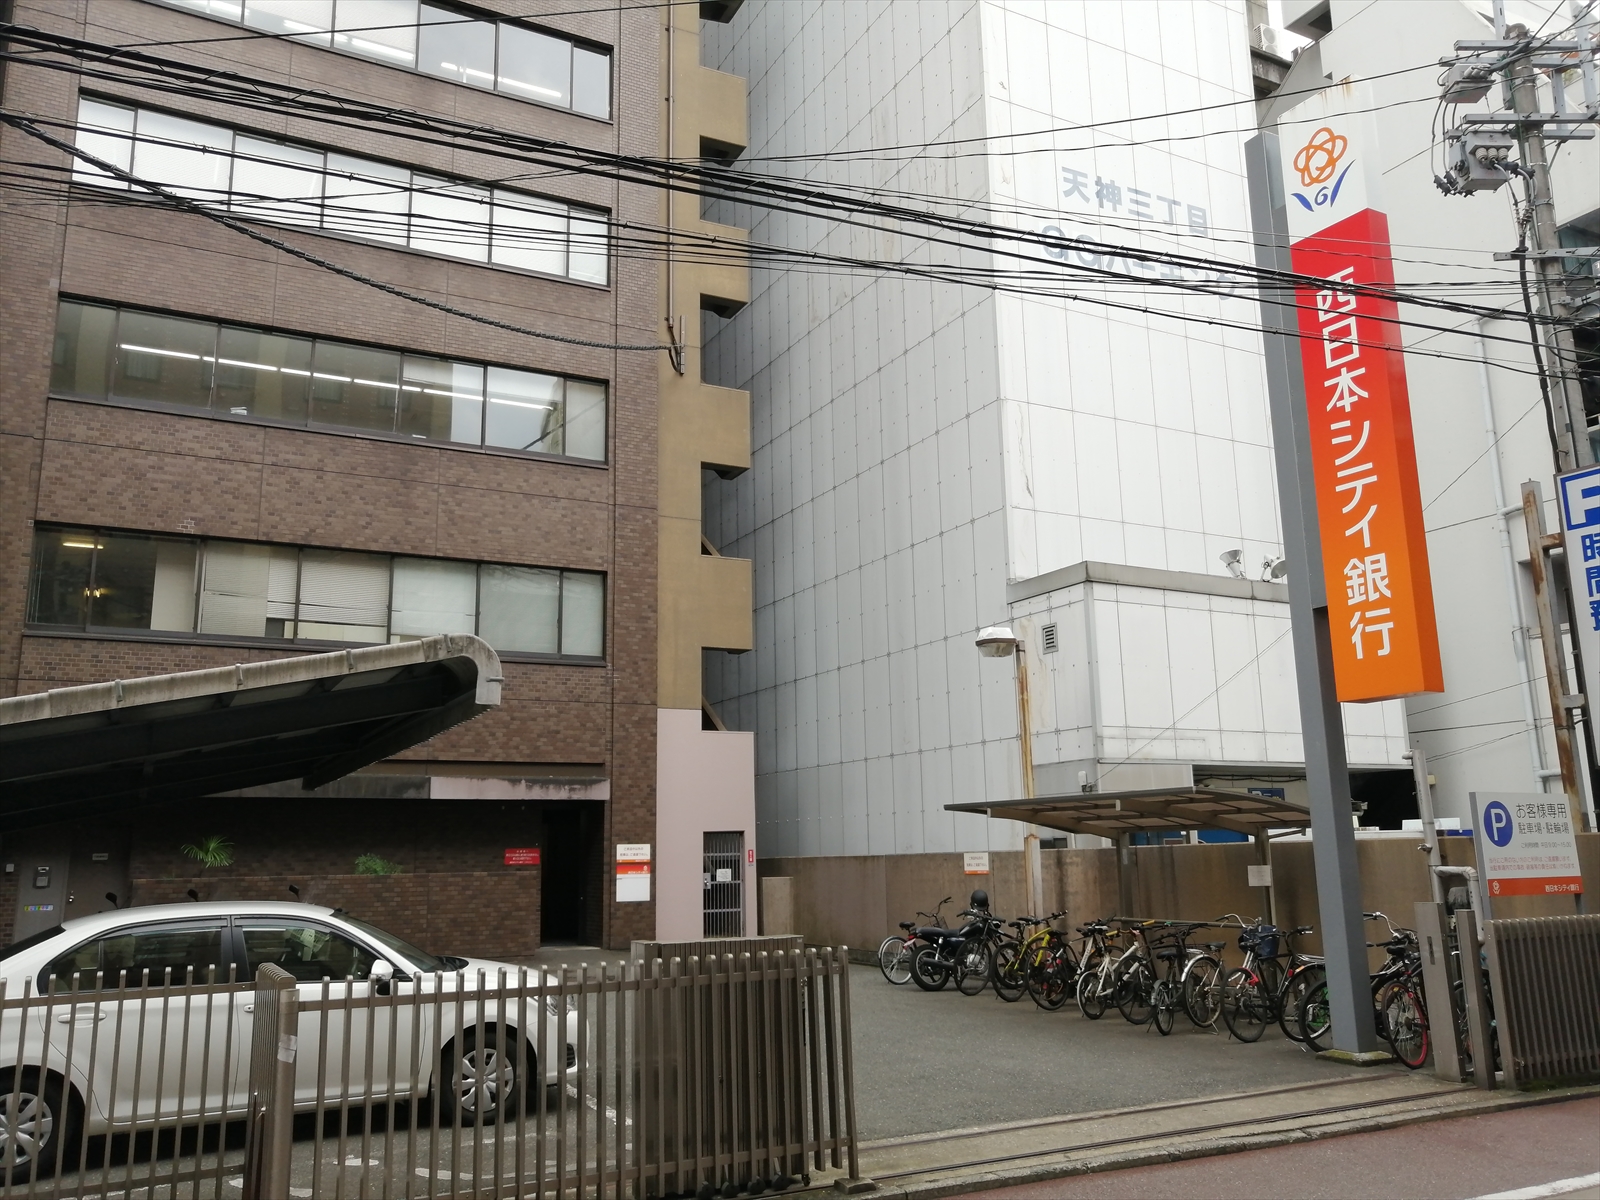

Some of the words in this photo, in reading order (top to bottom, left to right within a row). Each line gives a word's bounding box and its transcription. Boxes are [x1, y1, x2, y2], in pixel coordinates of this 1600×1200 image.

[1061, 166, 1209, 238] 天神三丁目
[1315, 265, 1394, 660] 西日本シティ銀行
[1490, 808, 1507, 841] P
[1515, 803, 1567, 819] お客様専用
[1517, 821, 1570, 835] 駐車場・駐輪場
